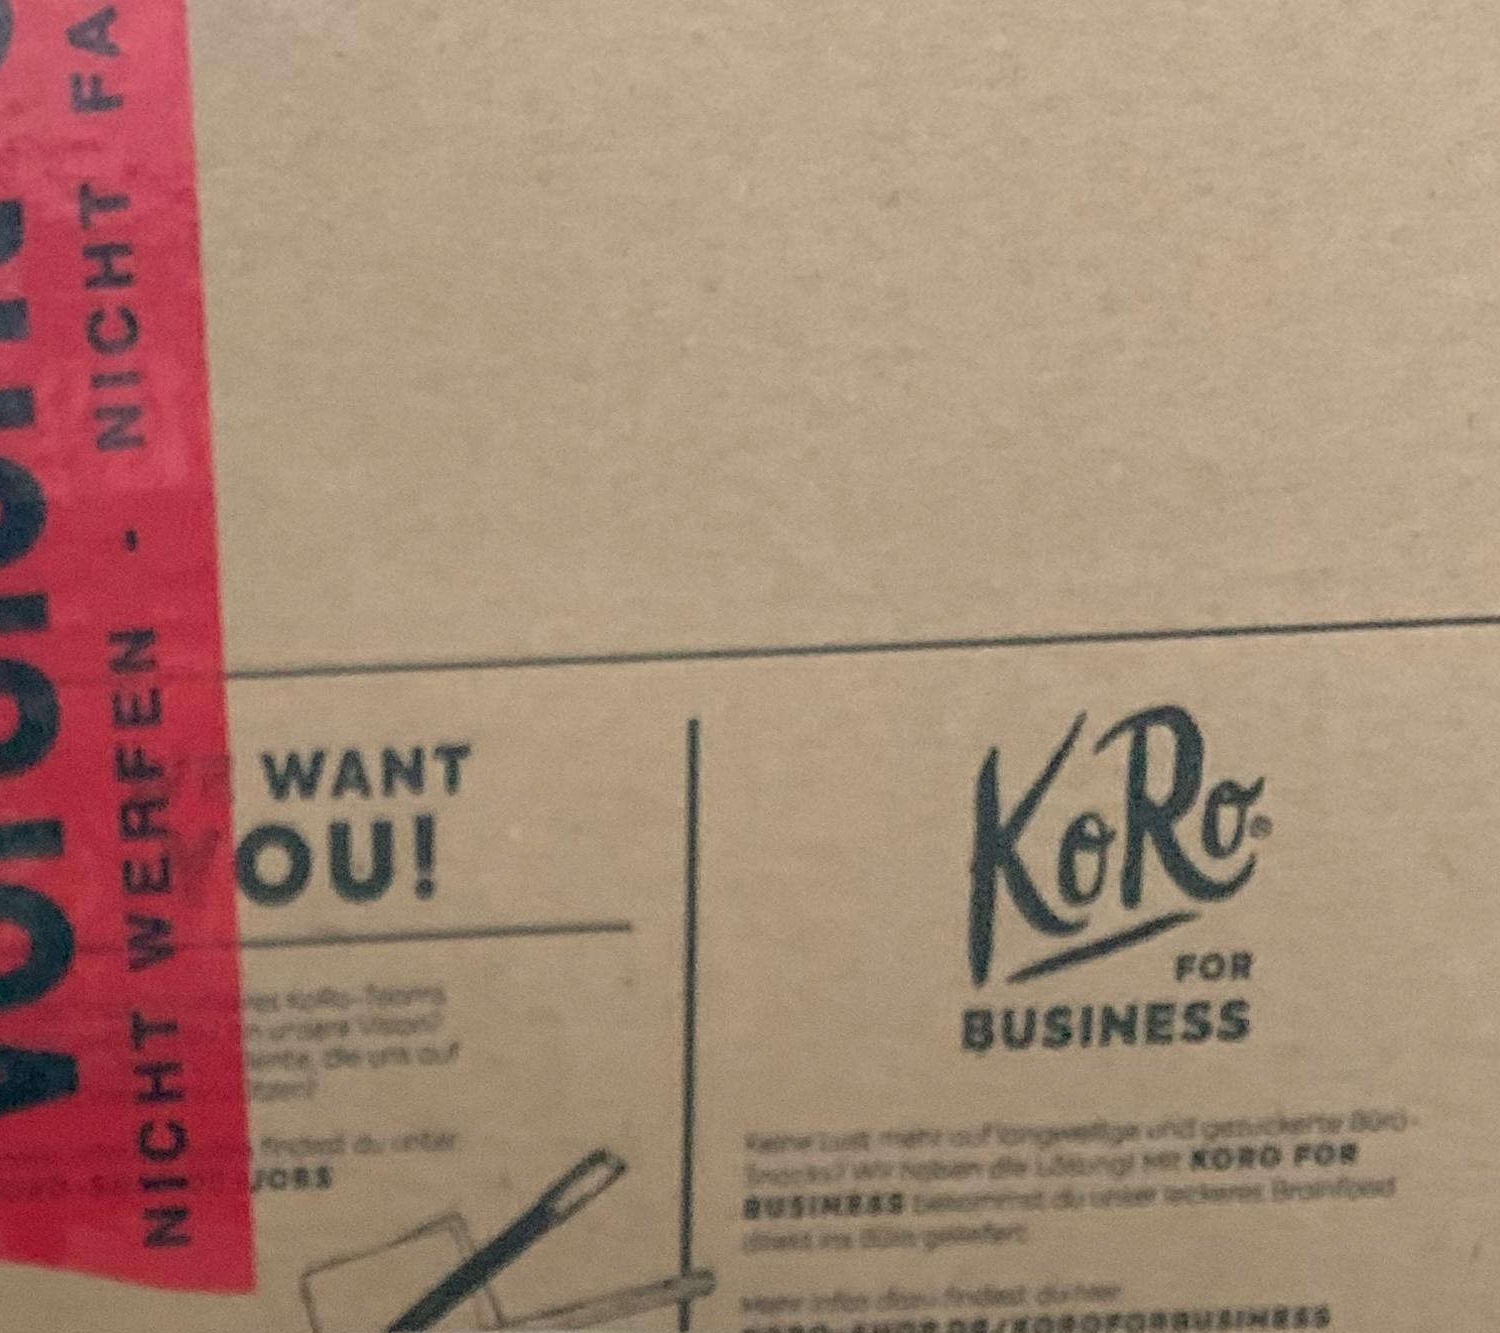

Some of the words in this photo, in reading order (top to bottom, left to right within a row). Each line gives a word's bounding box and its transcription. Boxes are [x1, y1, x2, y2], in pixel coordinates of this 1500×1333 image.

[65, 7, 126, 115] FA
[77, 183, 146, 452] NICHT
[108, 627, 176, 973] WERFEN
[260, 743, 473, 801] WANT
[1175, 950, 1254, 984] FOR
[961, 999, 1252, 1053] BUSINESS
[130, 1011, 192, 1249] NICHT
